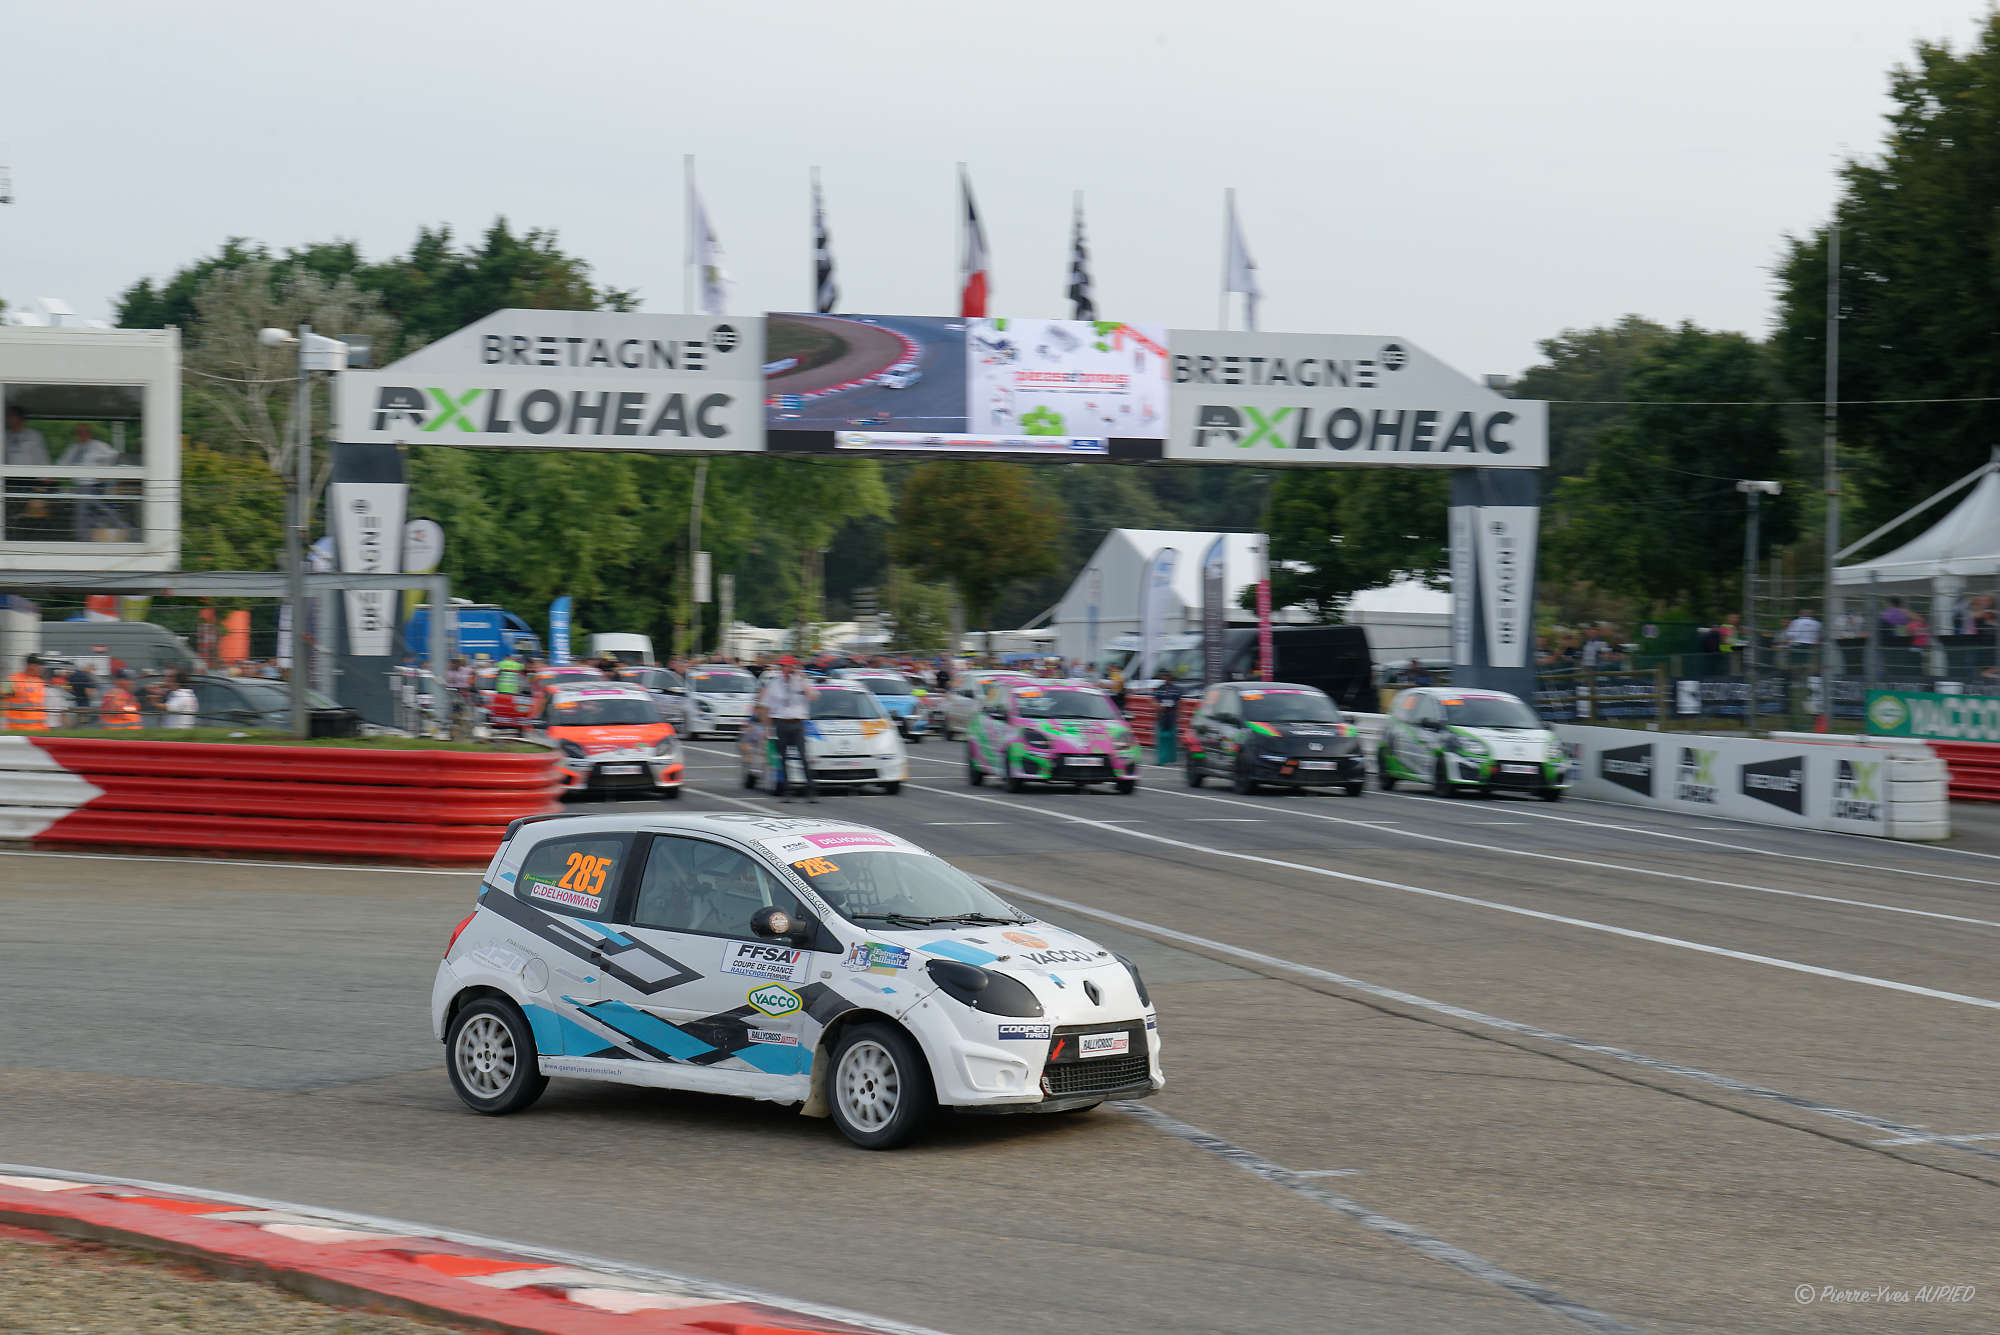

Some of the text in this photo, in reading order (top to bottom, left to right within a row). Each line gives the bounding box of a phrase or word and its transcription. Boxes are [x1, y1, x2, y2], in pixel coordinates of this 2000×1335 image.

[483, 334, 708, 371] BRETAGNE
[1173, 354, 1378, 389] BRETAGNE
[558, 852, 612, 895] 285
[794, 856, 840, 877] 285
[533, 884, 599, 910] C.DELHOMMAIS
[738, 944, 794, 964] FFSA
[1020, 950, 1092, 964] YACCO
[730, 967, 767, 978] RALLYCROSS
[733, 960, 794, 975] COUPE DE FRANCE
[754, 993, 795, 1008] YACCO
[752, 1030, 781, 1041] RALLYCROSS
[1000, 1025, 1049, 1033] COOPER
[1083, 1037, 1114, 1050] RALLYCROSS
